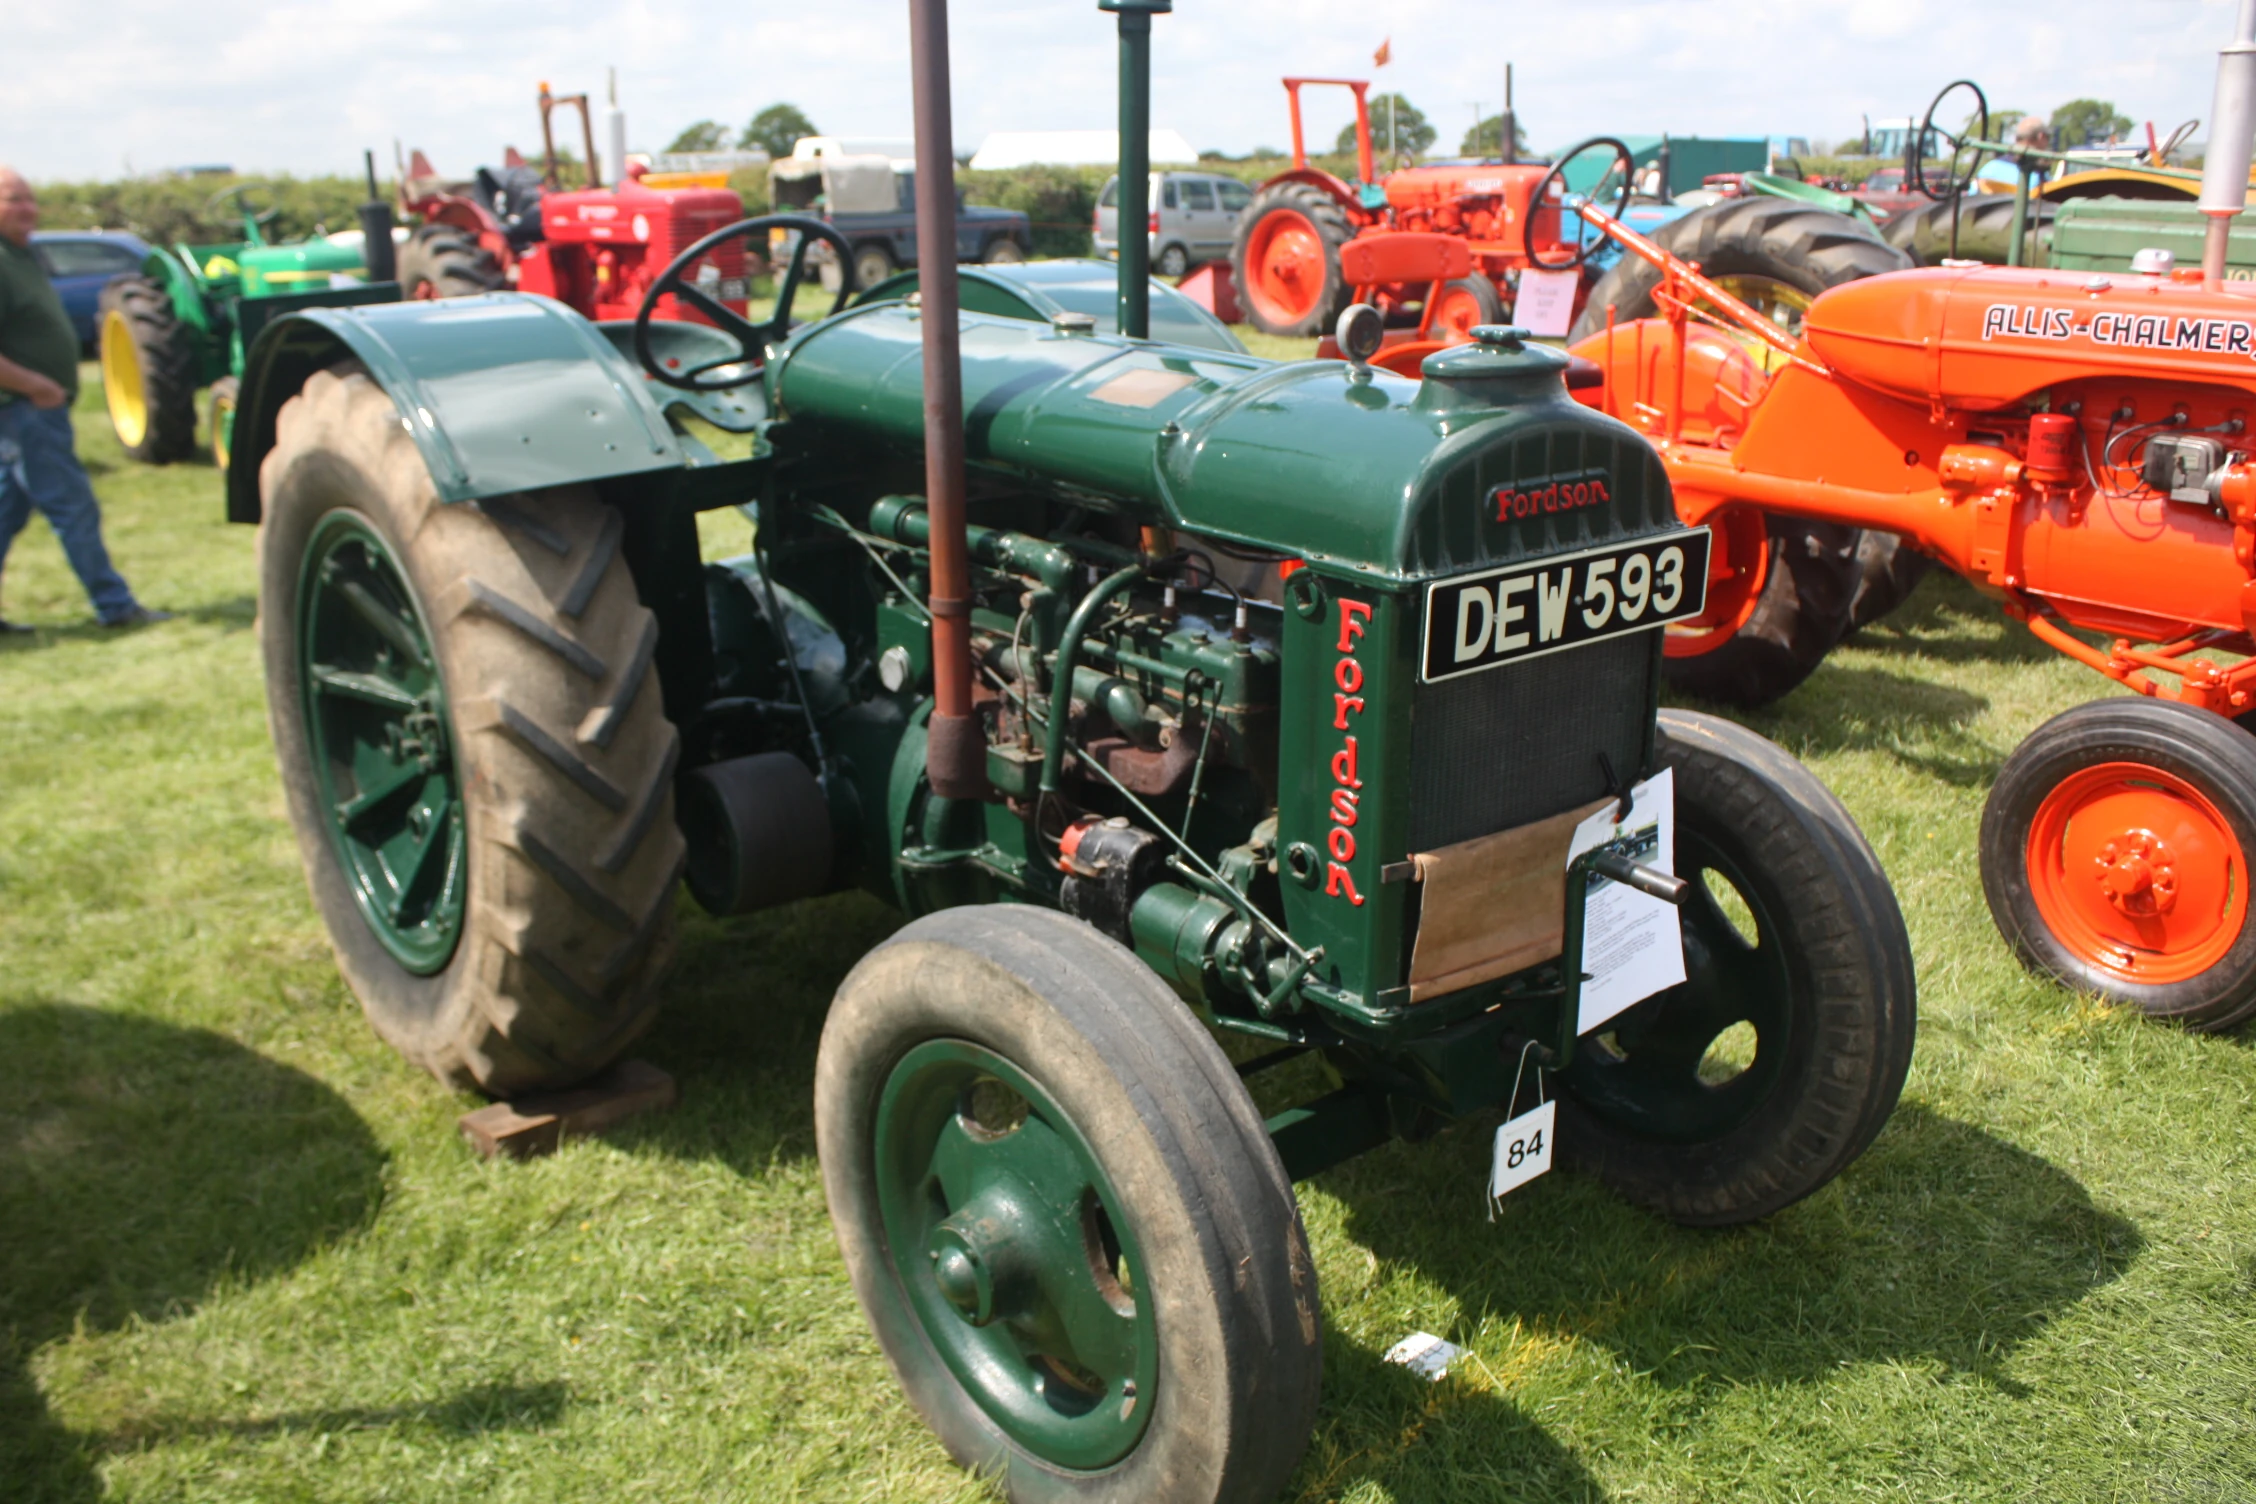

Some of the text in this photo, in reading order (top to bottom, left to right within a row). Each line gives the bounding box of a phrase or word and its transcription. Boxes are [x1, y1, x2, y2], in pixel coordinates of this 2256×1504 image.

[1983, 304, 2256, 358] ALLIS-CHALMER
[1496, 480, 1610, 522] Fordson
[1454, 546, 1684, 663] DEW 593
[1325, 598, 1372, 906] Fordson
[1507, 1128, 1544, 1169] 84
